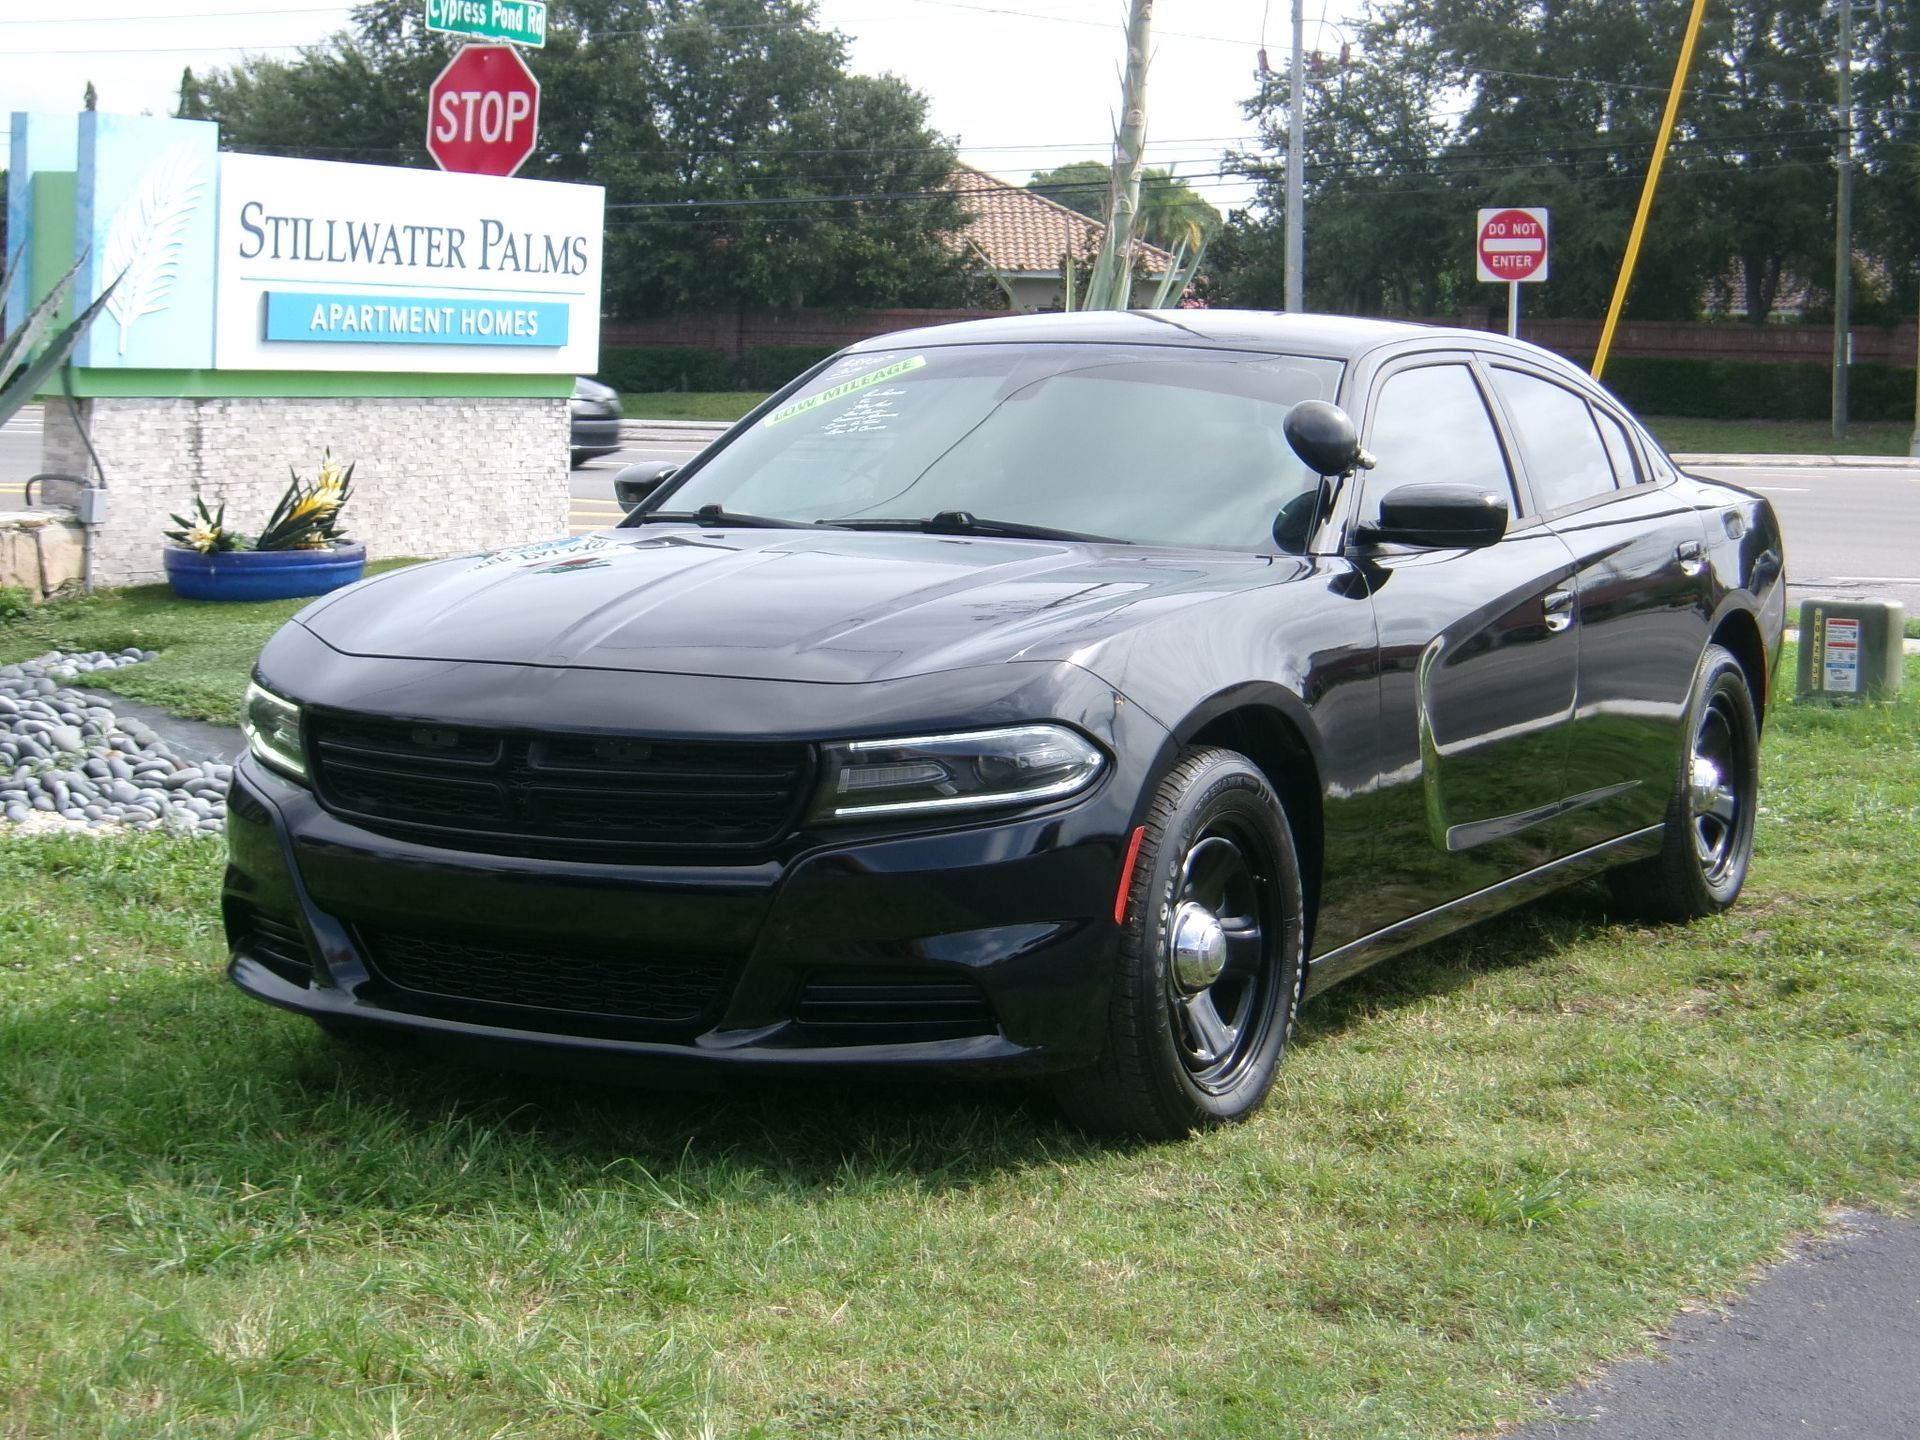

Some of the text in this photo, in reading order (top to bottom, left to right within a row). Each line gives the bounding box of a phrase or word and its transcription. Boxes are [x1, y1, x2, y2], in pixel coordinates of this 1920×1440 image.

[429, 0, 543, 35] Cypress Pond Rd
[435, 90, 531, 143] STOP
[1488, 222, 1537, 235] DO NOT
[1492, 255, 1532, 267] ENTER
[310, 303, 538, 336] APARTMENT HOMES
[774, 398, 817, 422] LOW
[822, 358, 913, 401] MILEAGE
